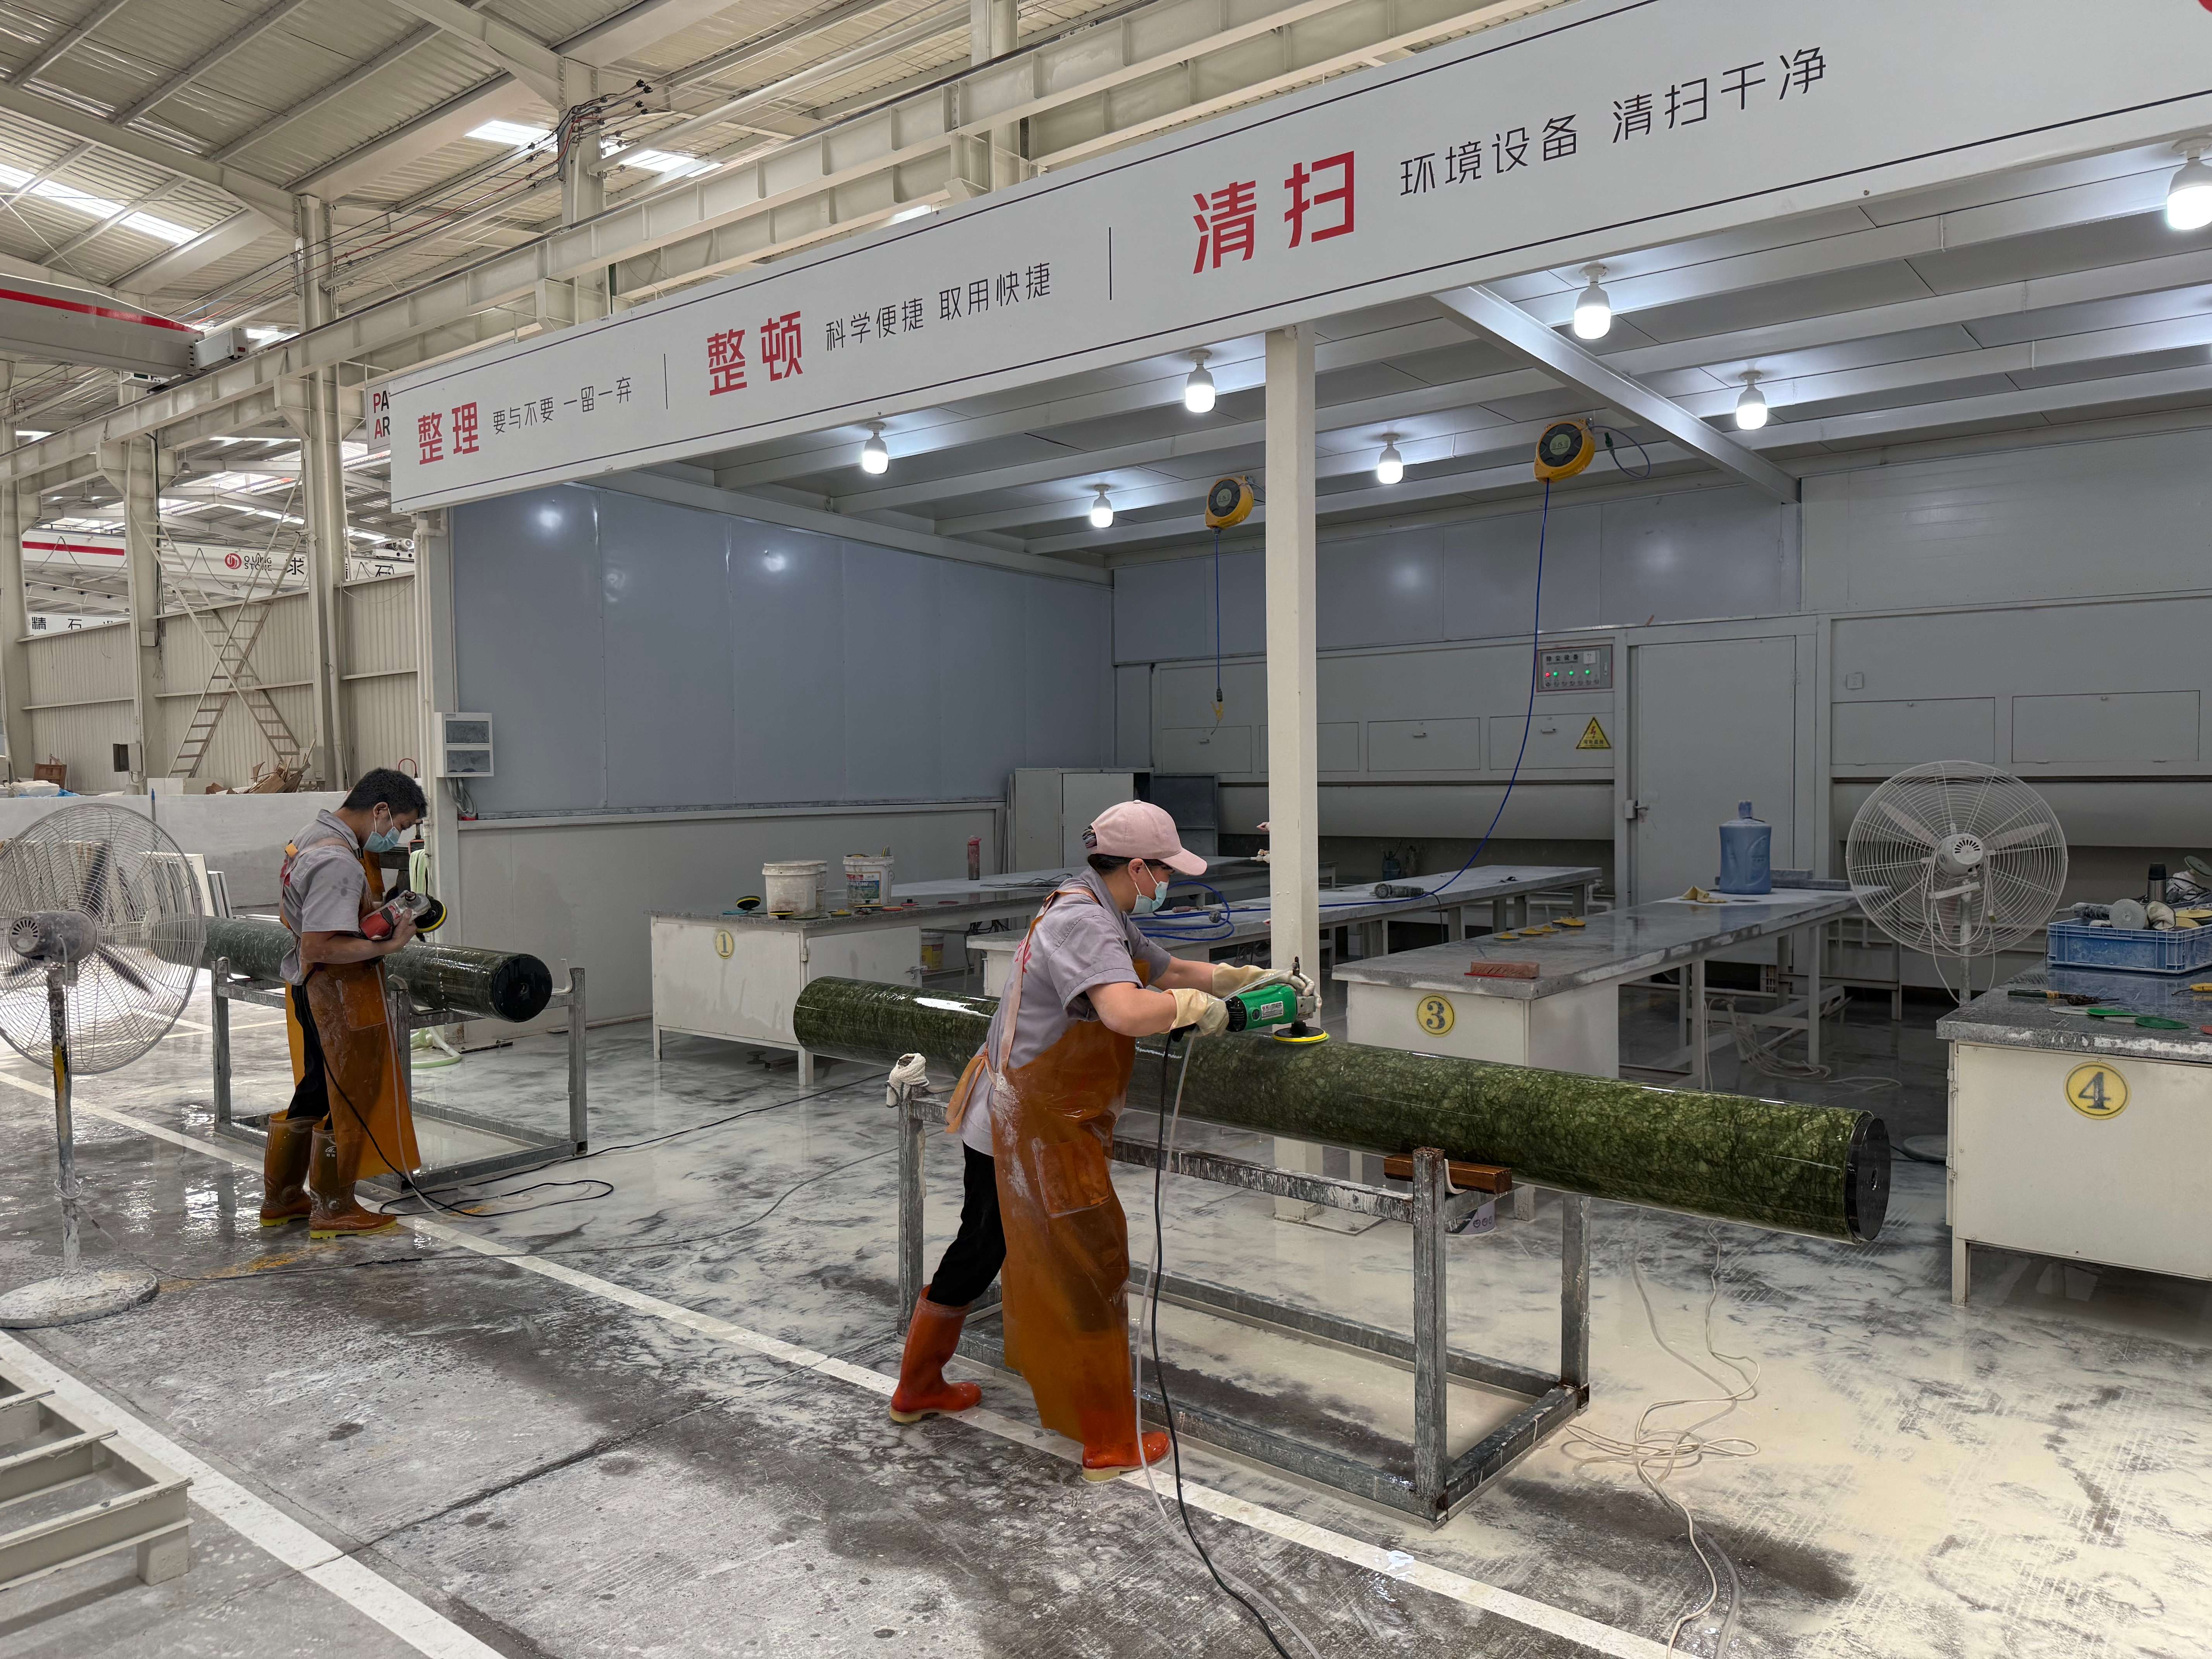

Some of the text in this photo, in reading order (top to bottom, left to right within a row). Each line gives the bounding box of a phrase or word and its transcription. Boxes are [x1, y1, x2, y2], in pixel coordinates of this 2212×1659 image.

[1193, 47, 1827, 274] 清扫 环境设备 清扫干净
[707, 263, 1051, 396] 整顿 科学便捷 取用快捷
[373, 390, 389, 413] PA
[374, 416, 390, 440] AR
[418, 377, 632, 465] 整理 要与不要 一留一弃
[720, 933, 729, 953] 1
[1426, 1001, 1445, 1030] 3
[2078, 1072, 2111, 1110] 4
